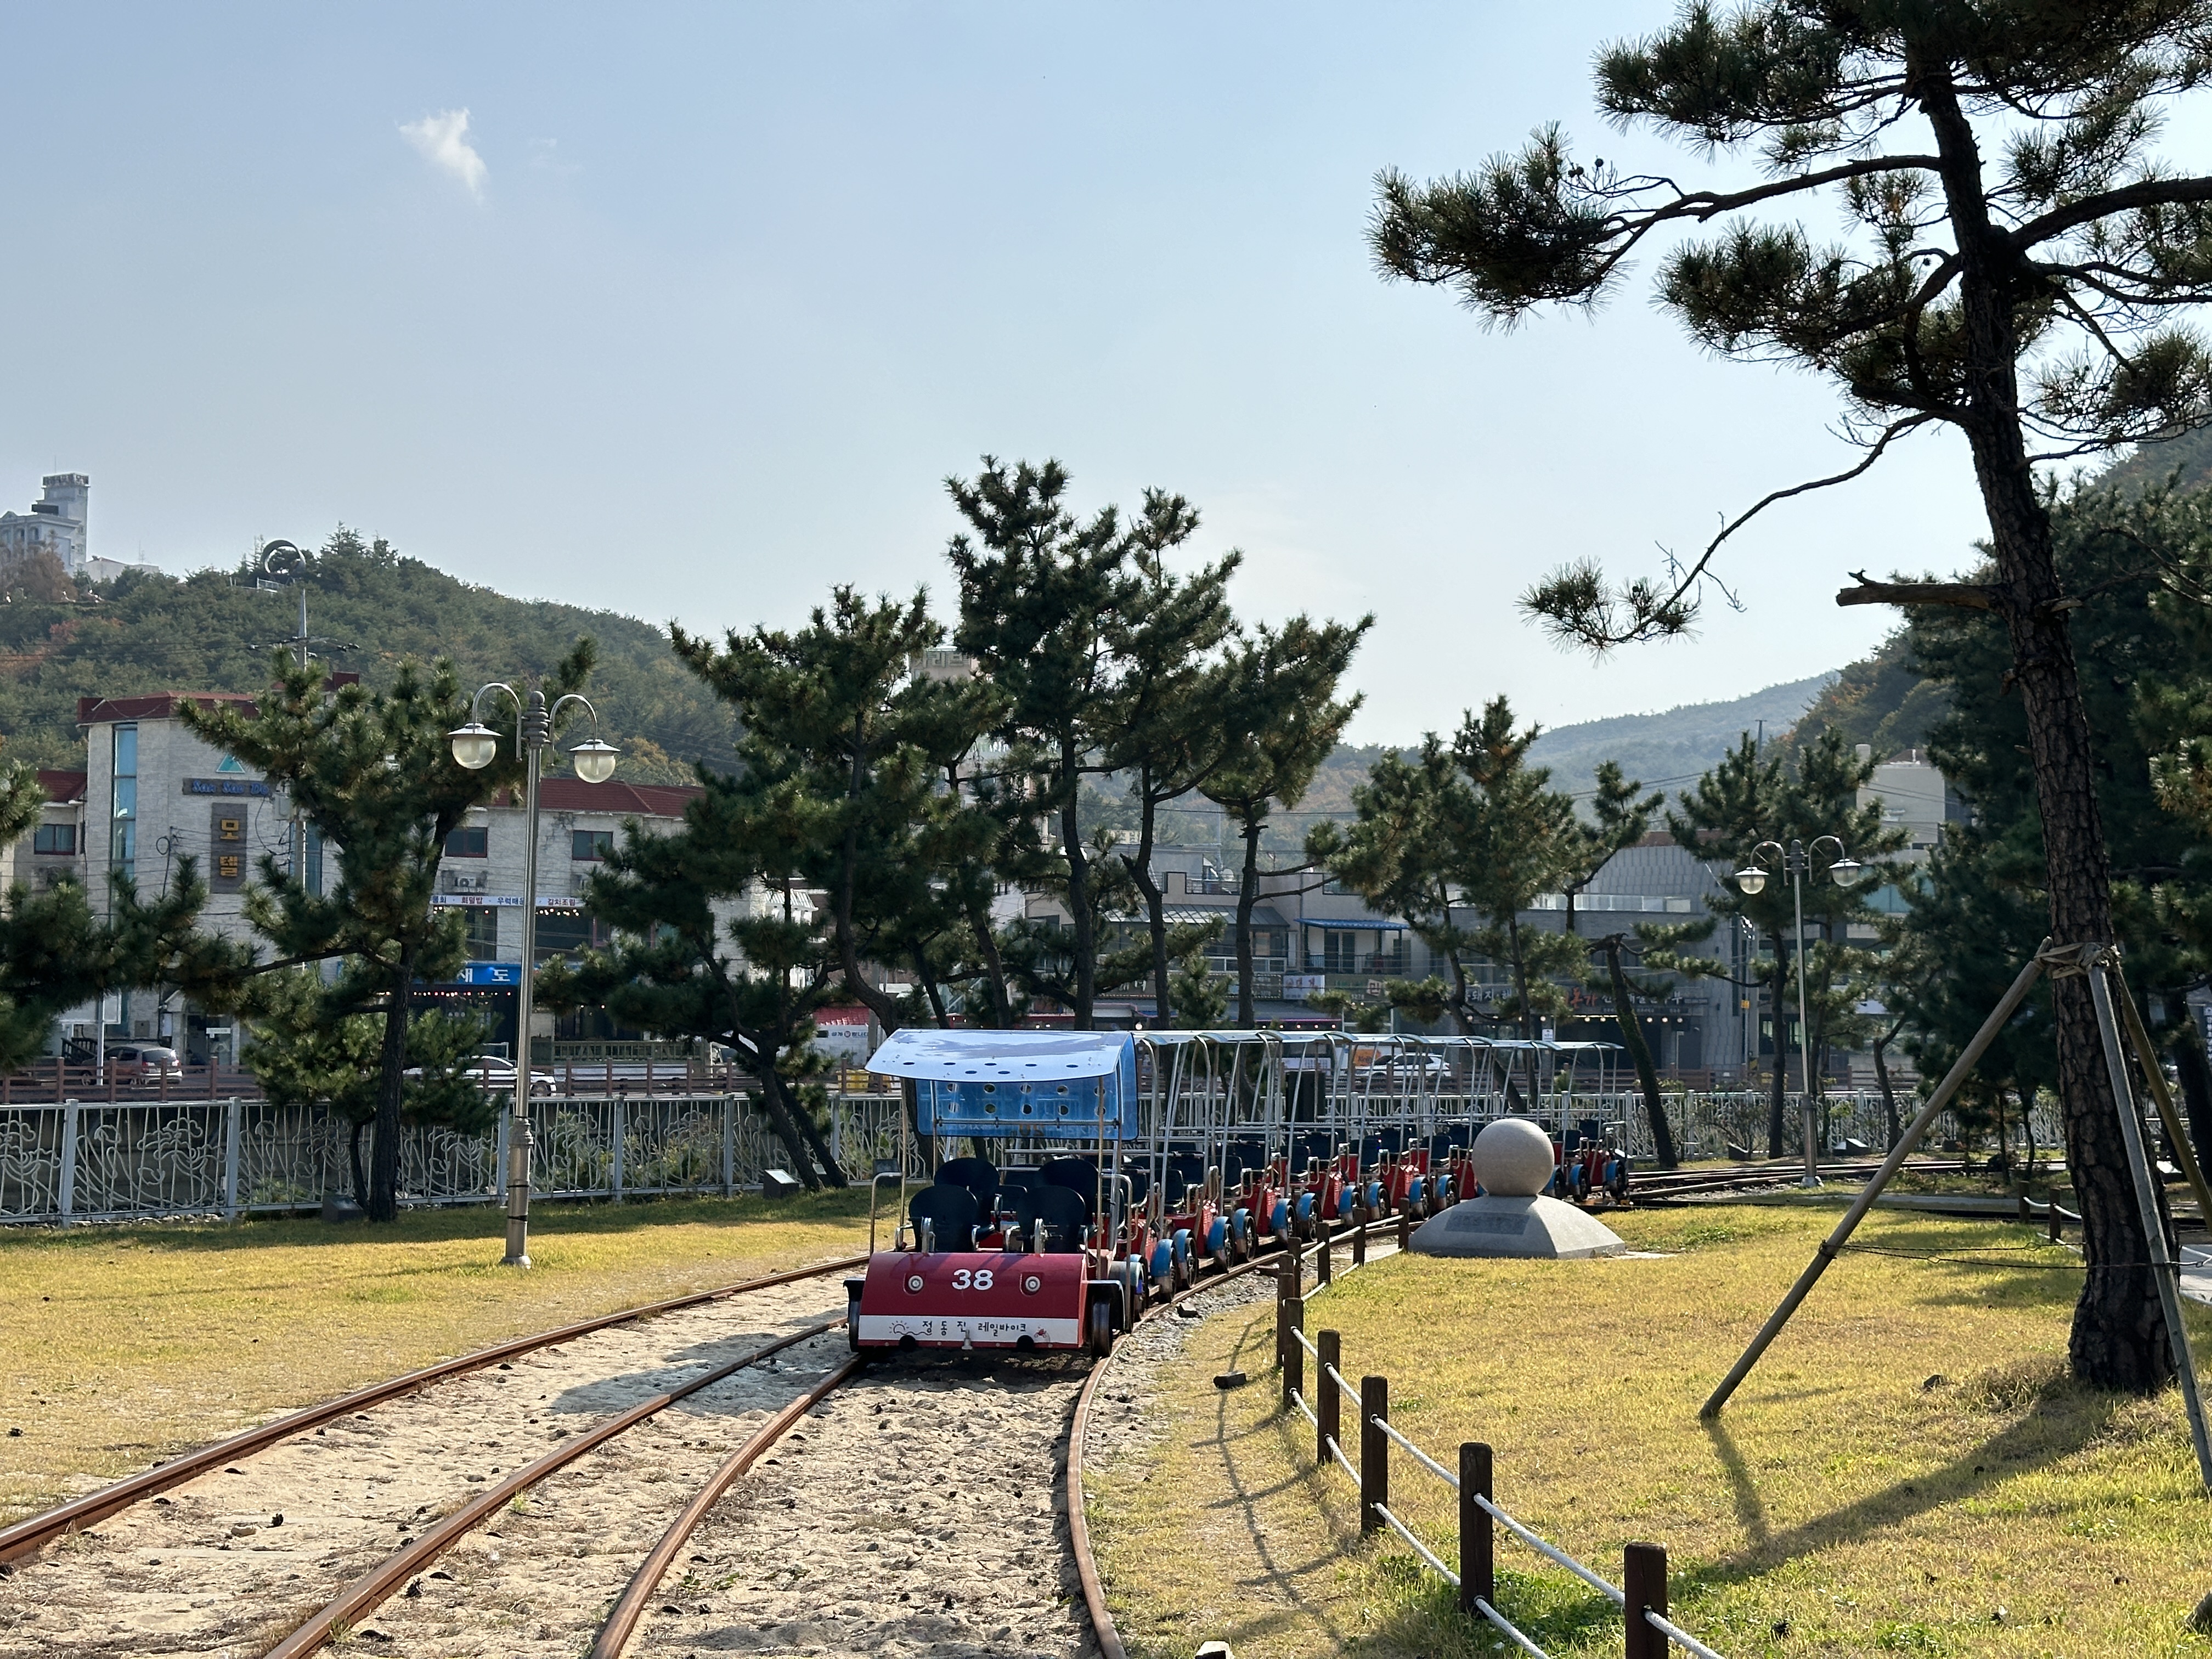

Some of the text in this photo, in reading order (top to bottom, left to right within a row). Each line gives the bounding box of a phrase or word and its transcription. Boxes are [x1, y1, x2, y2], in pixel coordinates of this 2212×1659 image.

[193, 781, 216, 793] San
[251, 783, 269, 794] Do
[220, 819, 239, 876] 모텔
[952, 1269, 994, 1290] 38
[978, 1322, 1026, 1336] 레일바이크
